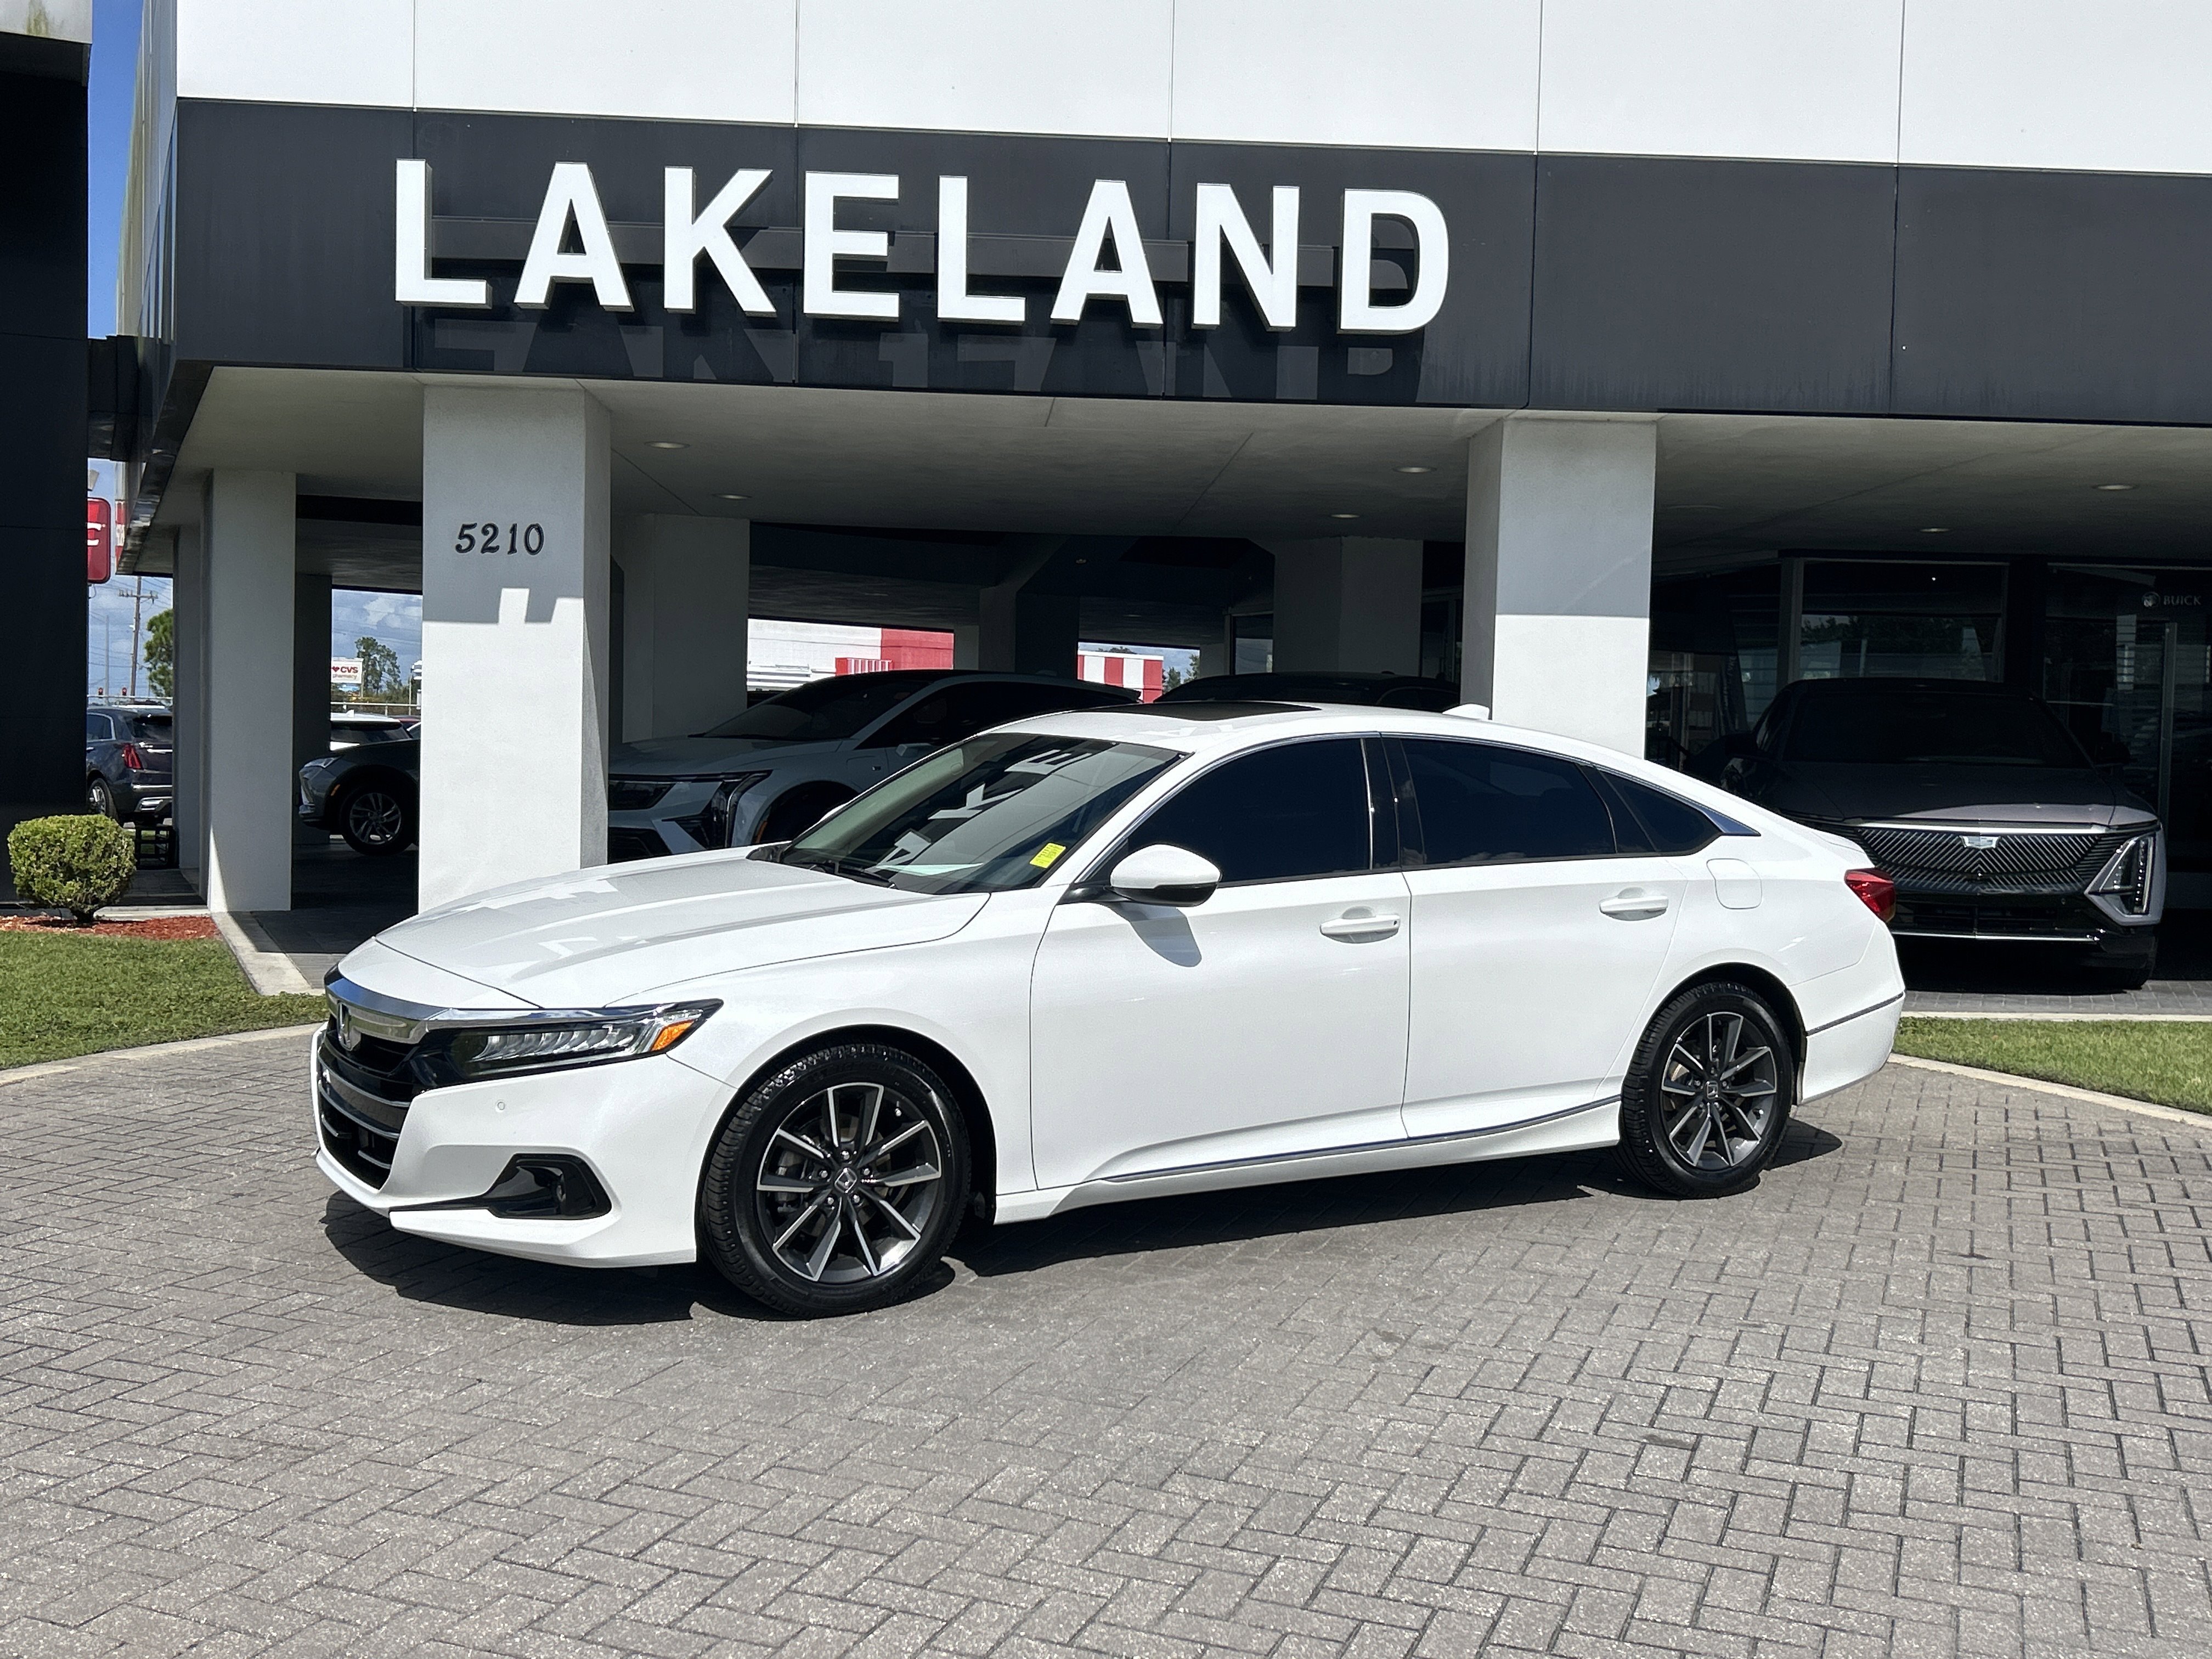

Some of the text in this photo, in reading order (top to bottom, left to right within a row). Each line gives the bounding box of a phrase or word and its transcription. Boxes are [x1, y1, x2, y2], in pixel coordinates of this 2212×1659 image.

[394, 159, 1449, 333] LAKELAND
[455, 523, 544, 556] 5210
[2163, 595, 2202, 605] BUICK
